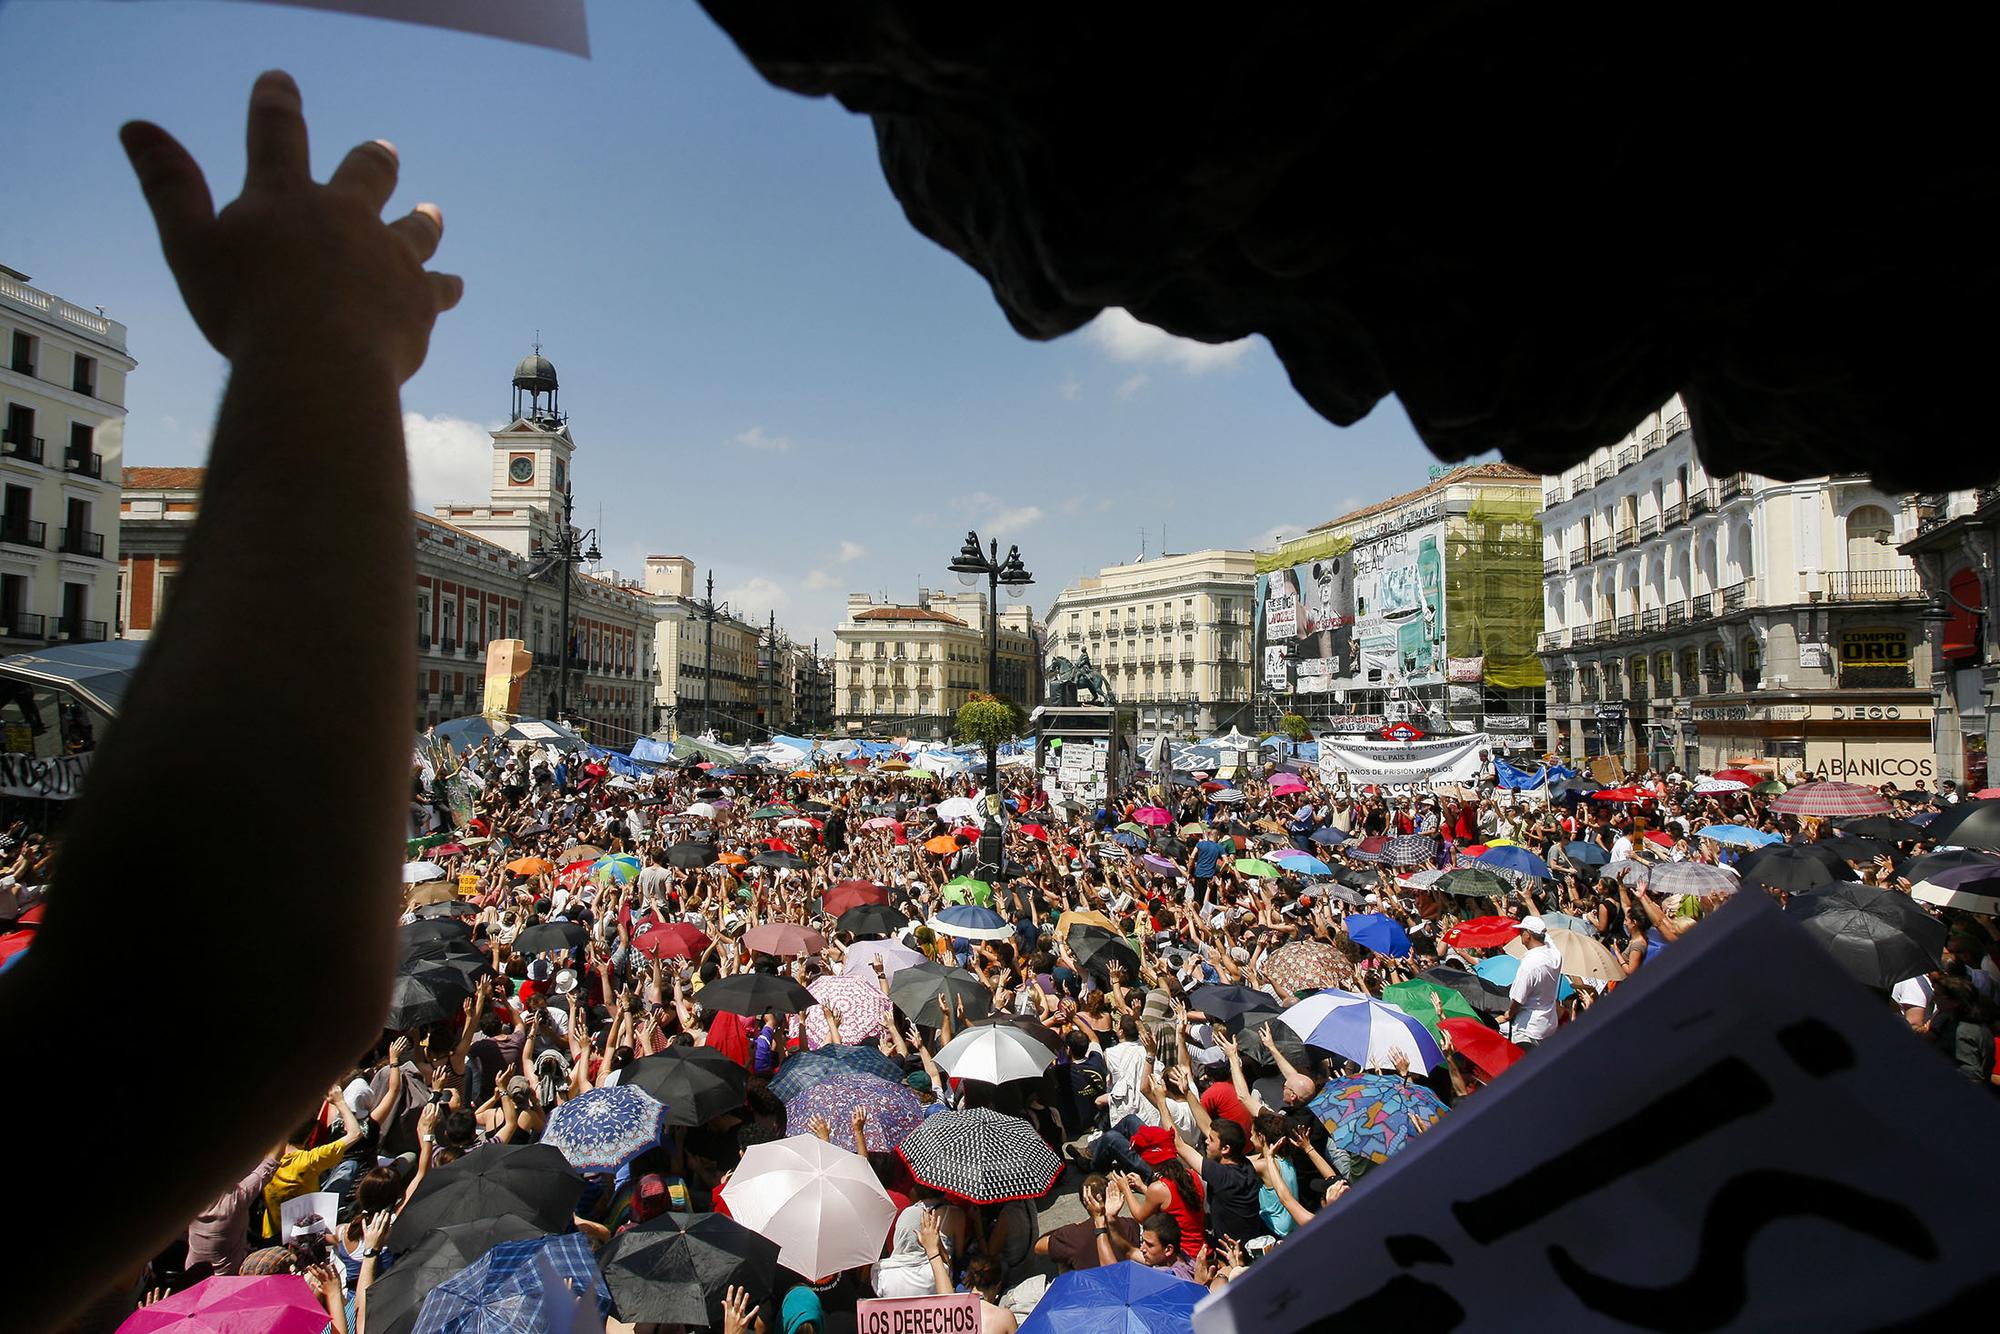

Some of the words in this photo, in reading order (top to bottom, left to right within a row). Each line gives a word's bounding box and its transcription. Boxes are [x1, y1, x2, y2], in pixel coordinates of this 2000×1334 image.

[1359, 557, 1383, 574] REAL
[1843, 633, 1906, 641] COMPRO
[1844, 642, 1906, 659] ORO
[1832, 705, 1900, 720] DIEGO
[1350, 767, 1371, 775] AÑOS
[1781, 758, 1804, 774] DIEGO
[1816, 758, 1932, 776] ABANICOS
[861, 1311, 889, 1334] LOS
[894, 1305, 979, 1334] DERECHOS,
